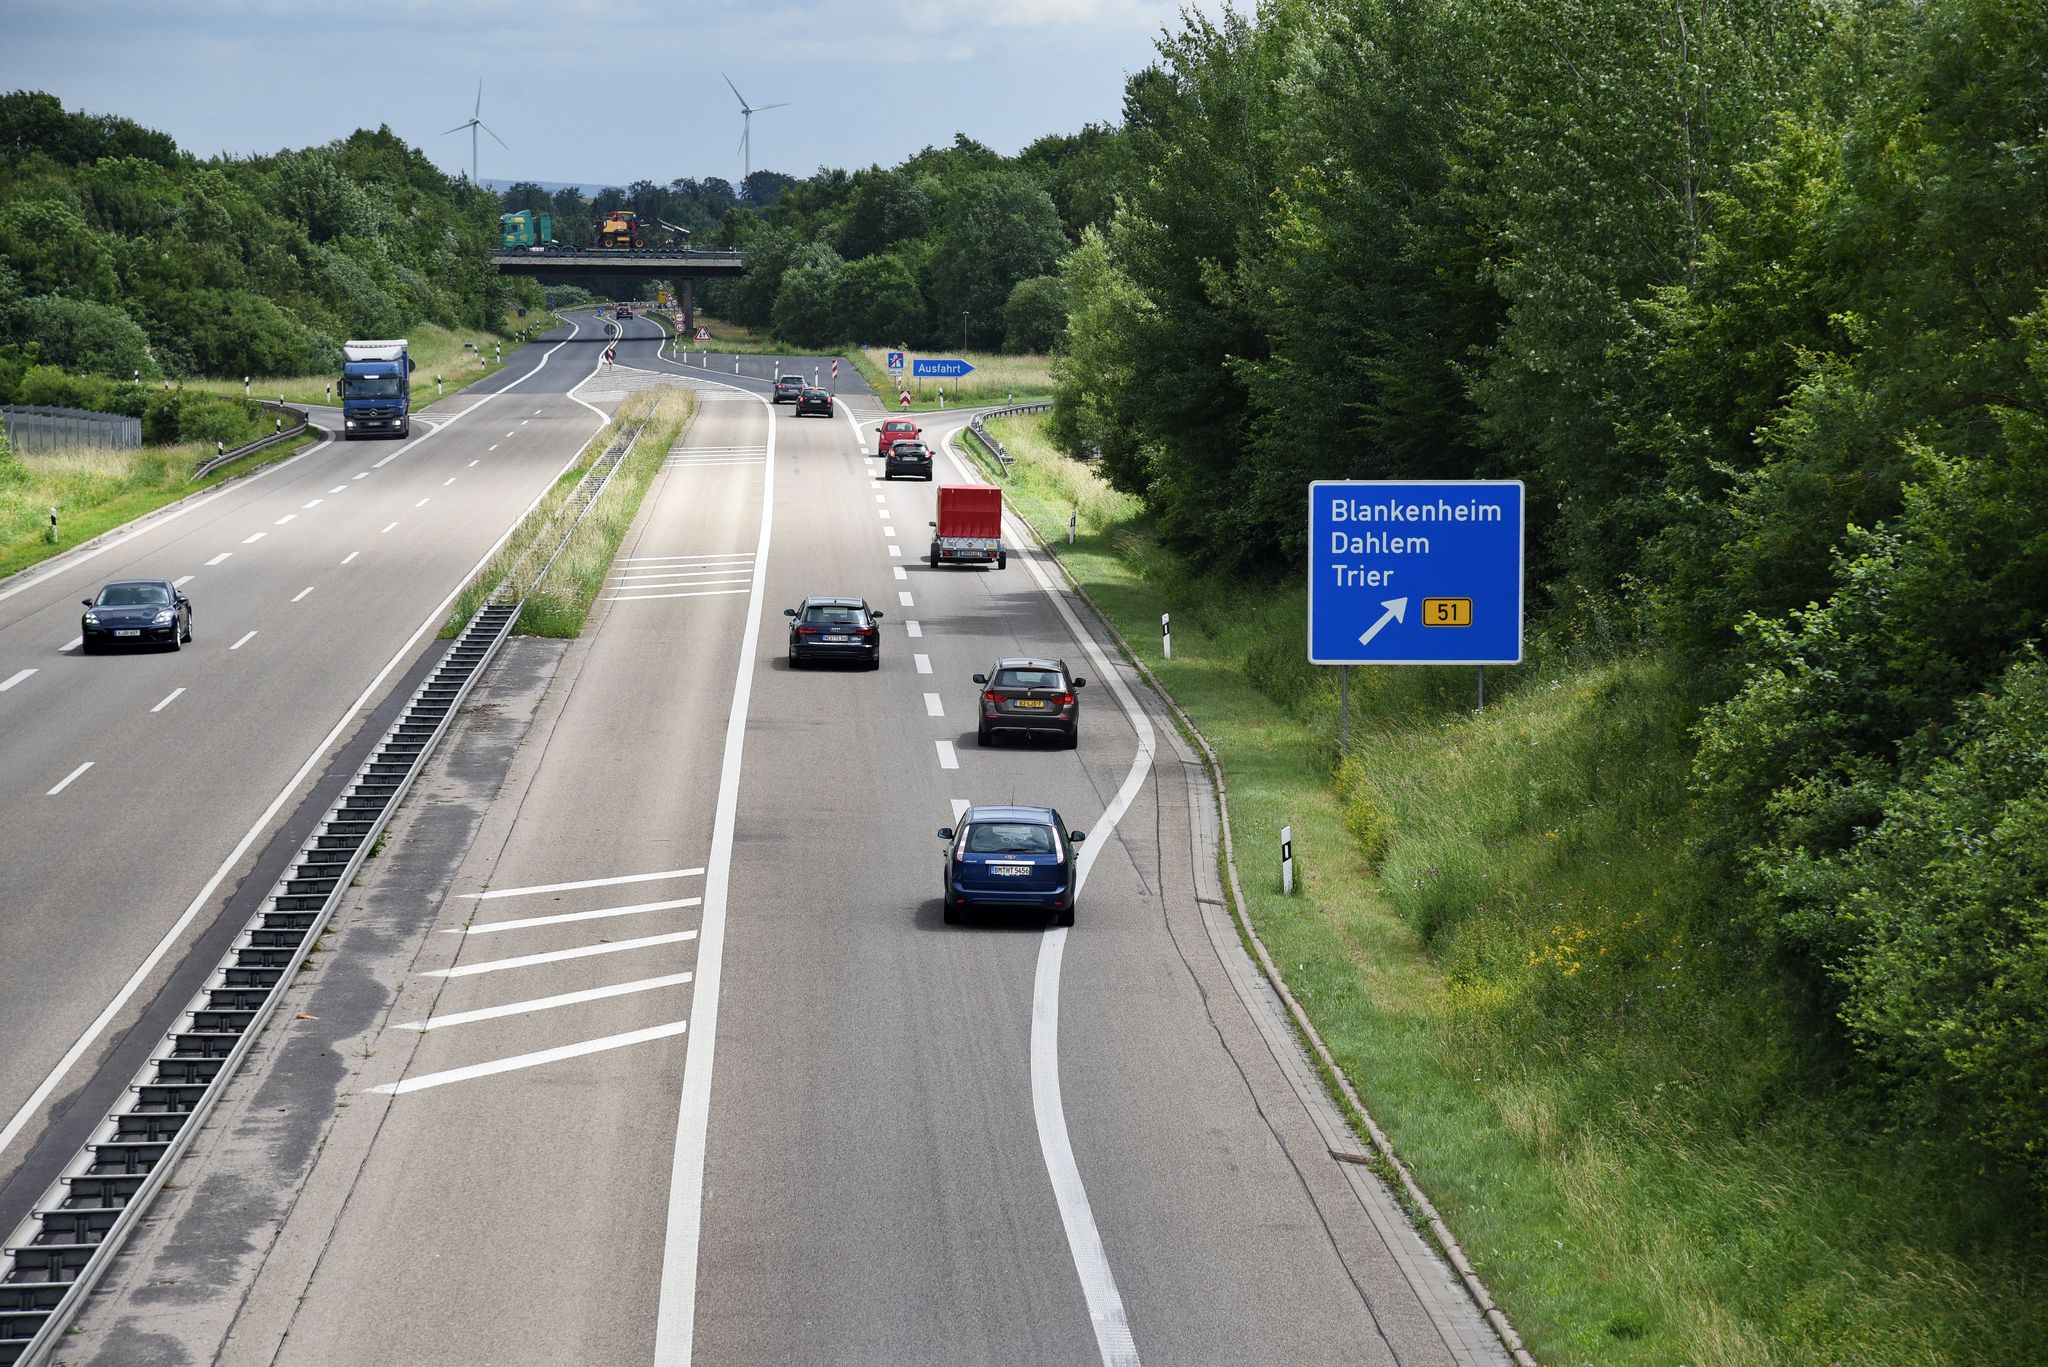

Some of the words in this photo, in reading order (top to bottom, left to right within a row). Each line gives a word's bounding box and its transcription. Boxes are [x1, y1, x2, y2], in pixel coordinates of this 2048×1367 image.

[918, 363, 961, 374] Ausfahrt
[1331, 499, 1501, 522] Blankenheim
[1331, 531, 1430, 554] Dahlem
[1331, 564, 1394, 587] Trier
[1437, 603, 1457, 621] 51
